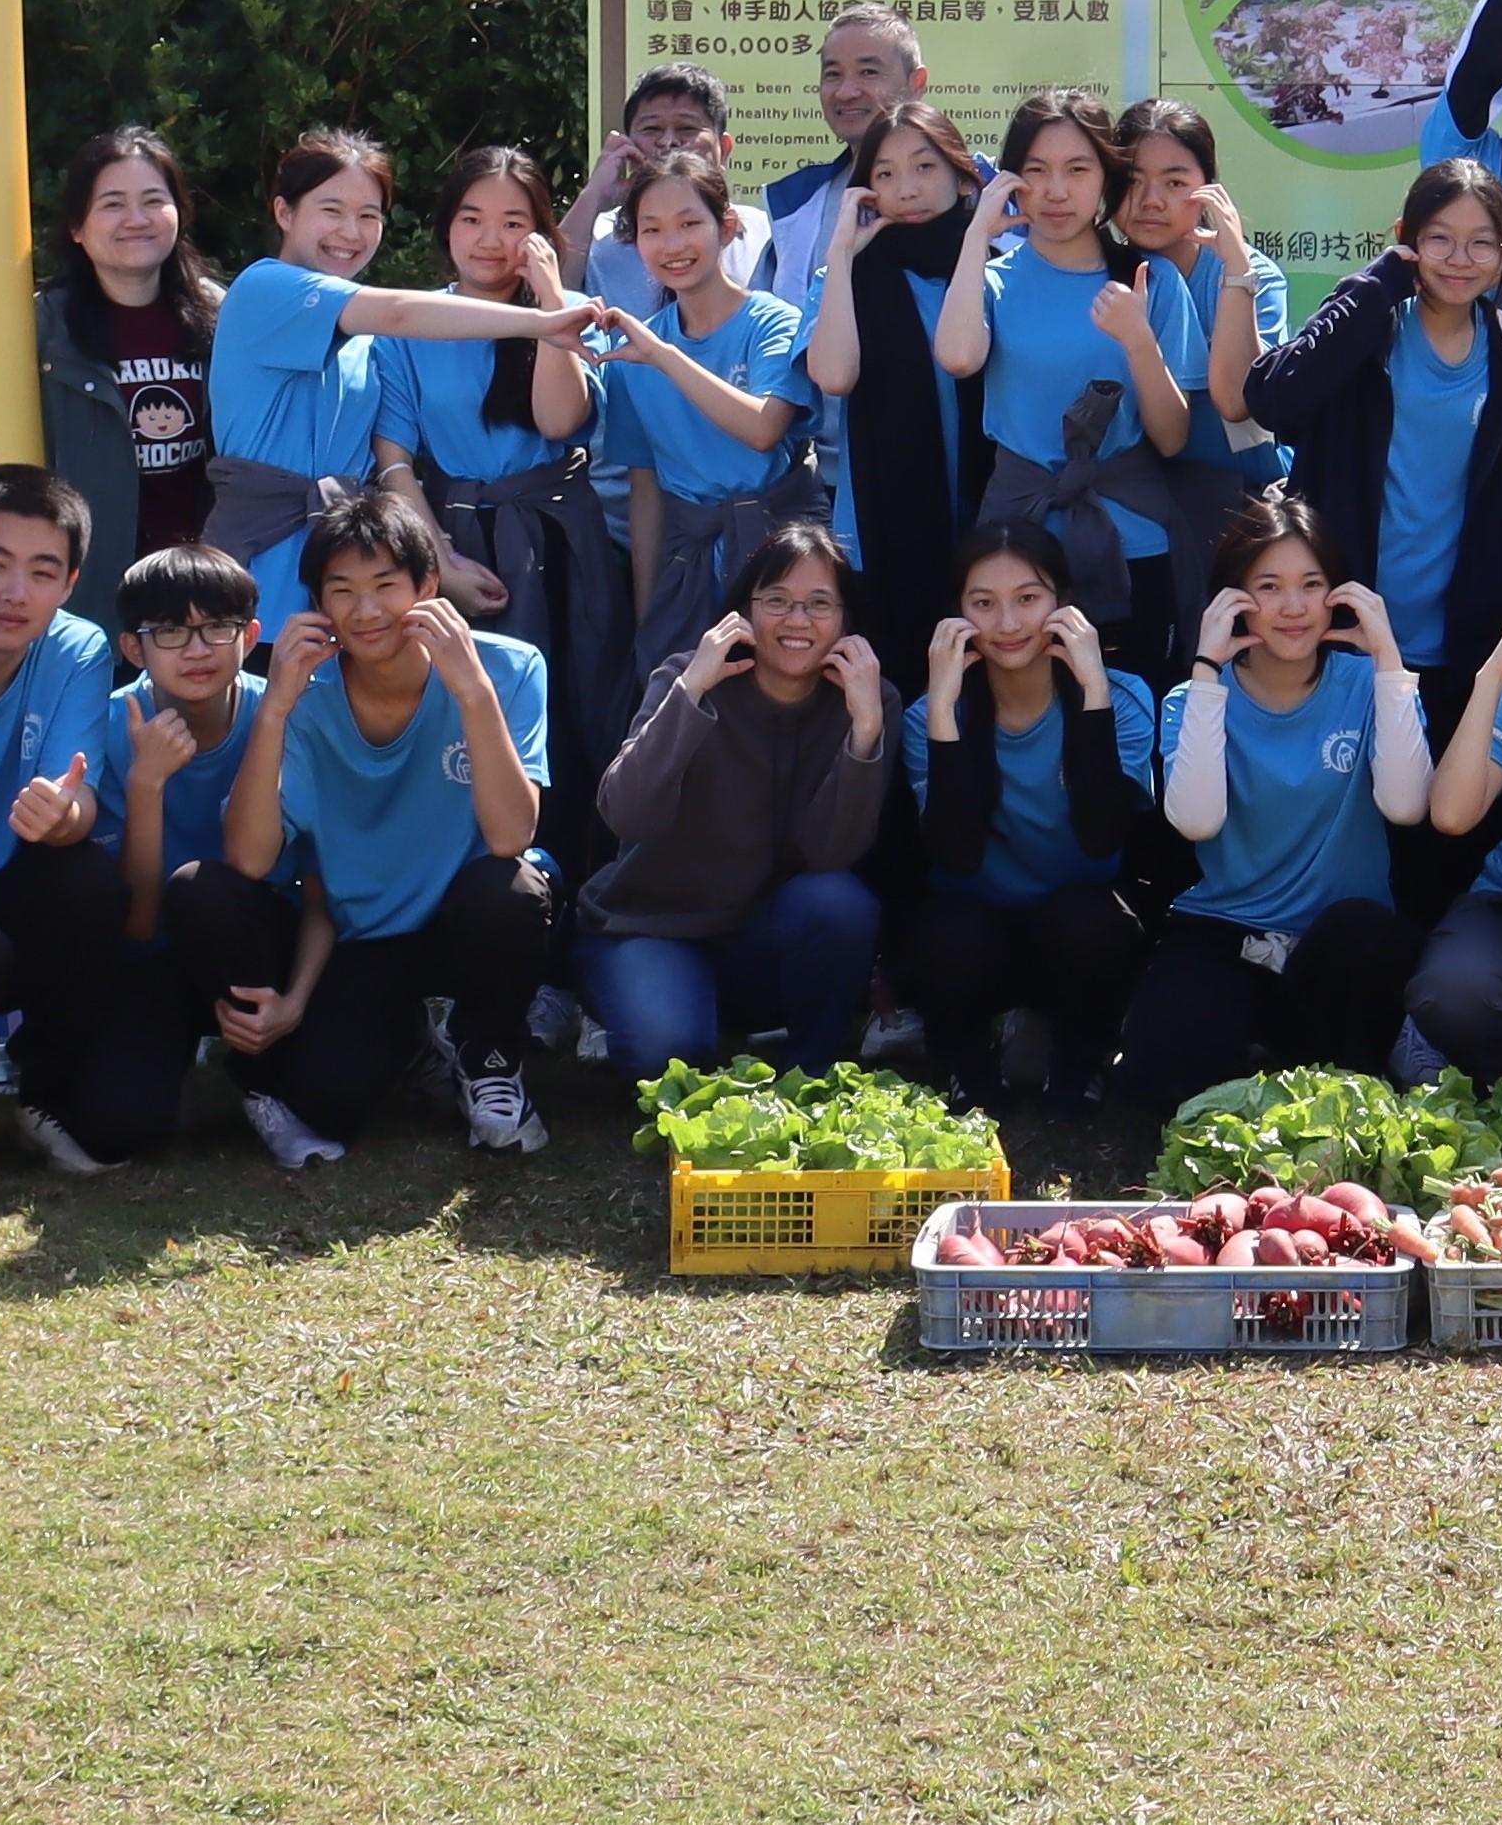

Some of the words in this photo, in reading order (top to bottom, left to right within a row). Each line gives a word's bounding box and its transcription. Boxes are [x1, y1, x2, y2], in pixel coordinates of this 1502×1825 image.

[647, 32, 825, 57] 多達60,000多
[756, 81, 792, 94] been
[736, 107, 789, 121] healthy
[792, 107, 825, 120] livin
[734, 132, 830, 147] development
[761, 157, 788, 170] For
